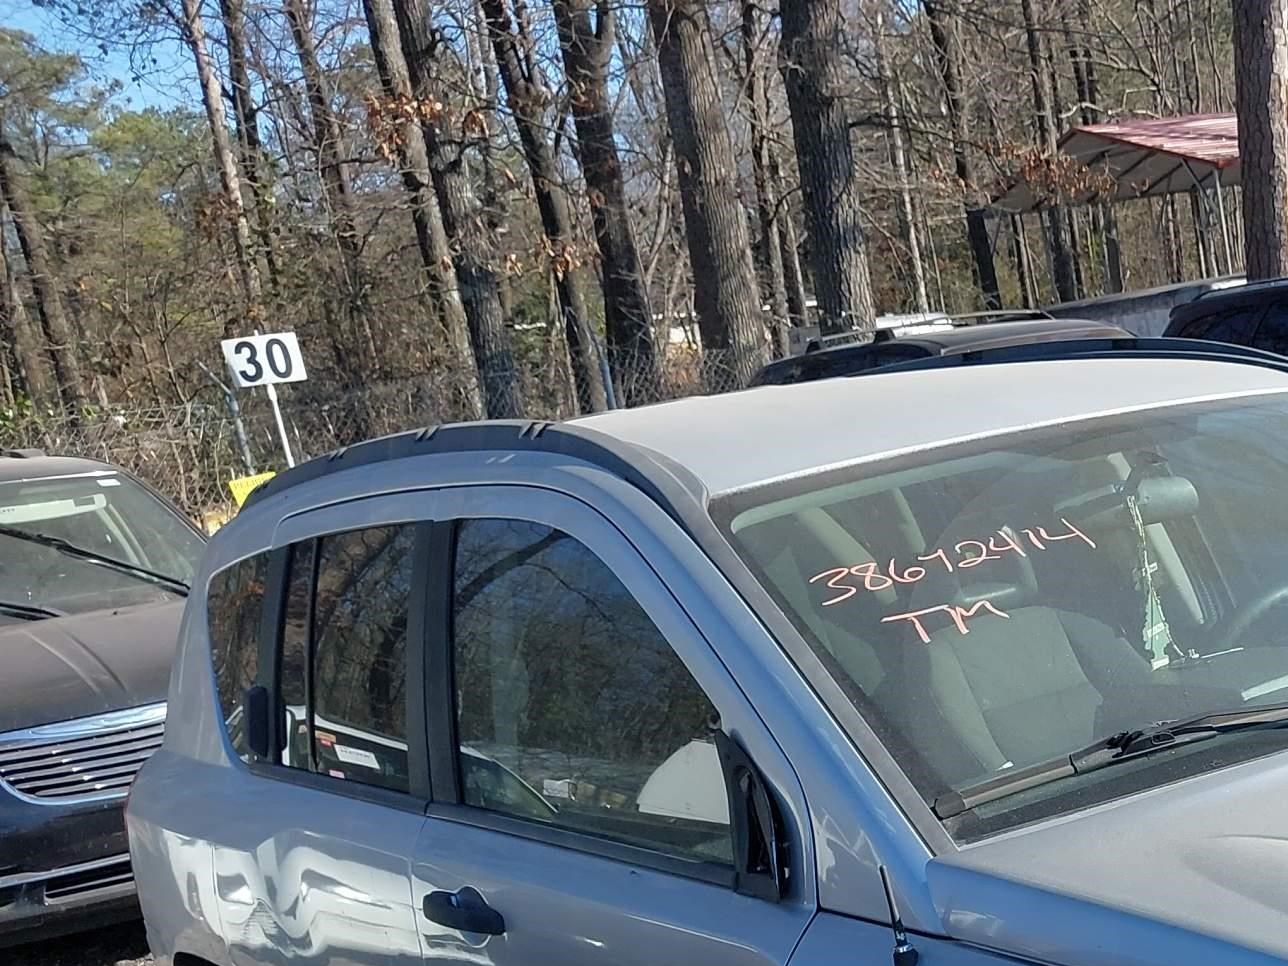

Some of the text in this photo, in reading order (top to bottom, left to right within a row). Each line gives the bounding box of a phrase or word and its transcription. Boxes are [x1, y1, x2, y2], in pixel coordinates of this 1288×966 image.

[234, 338, 293, 383] 30
[808, 517, 1097, 606] 38672414
[880, 599, 1010, 643] TM
